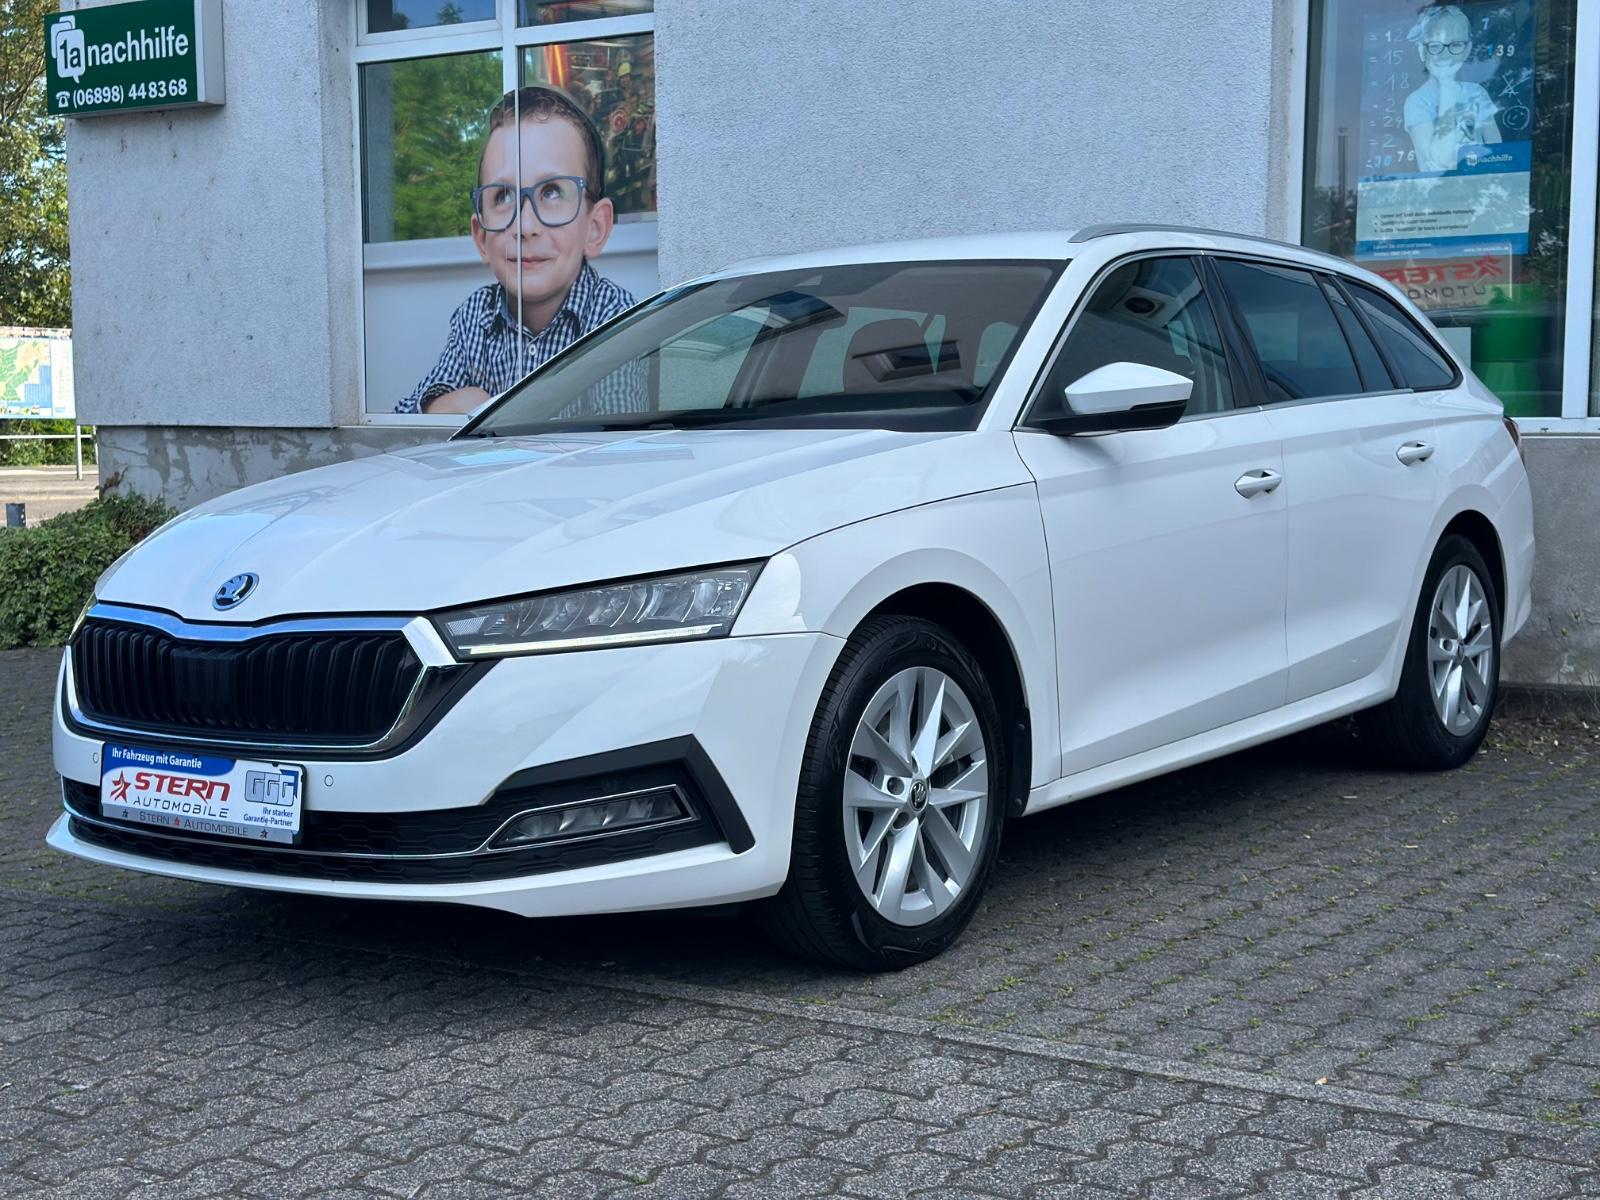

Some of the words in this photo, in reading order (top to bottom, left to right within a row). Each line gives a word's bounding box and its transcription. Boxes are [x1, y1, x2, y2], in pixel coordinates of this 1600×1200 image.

[59, 39, 82, 69] 1a
[87, 25, 189, 67] nachhilfe
[72, 85, 125, 109] (06898)
[112, 747, 121, 759] Ihr
[122, 749, 155, 765] Fahrzeug
[155, 753, 168, 765] mit
[169, 755, 202, 769] Garantie
[134, 772, 231, 804] STERN
[133, 796, 229, 818] AUTOMOBILE
[272, 808, 293, 818] starker
[243, 813, 293, 827] Garantie-Partner
